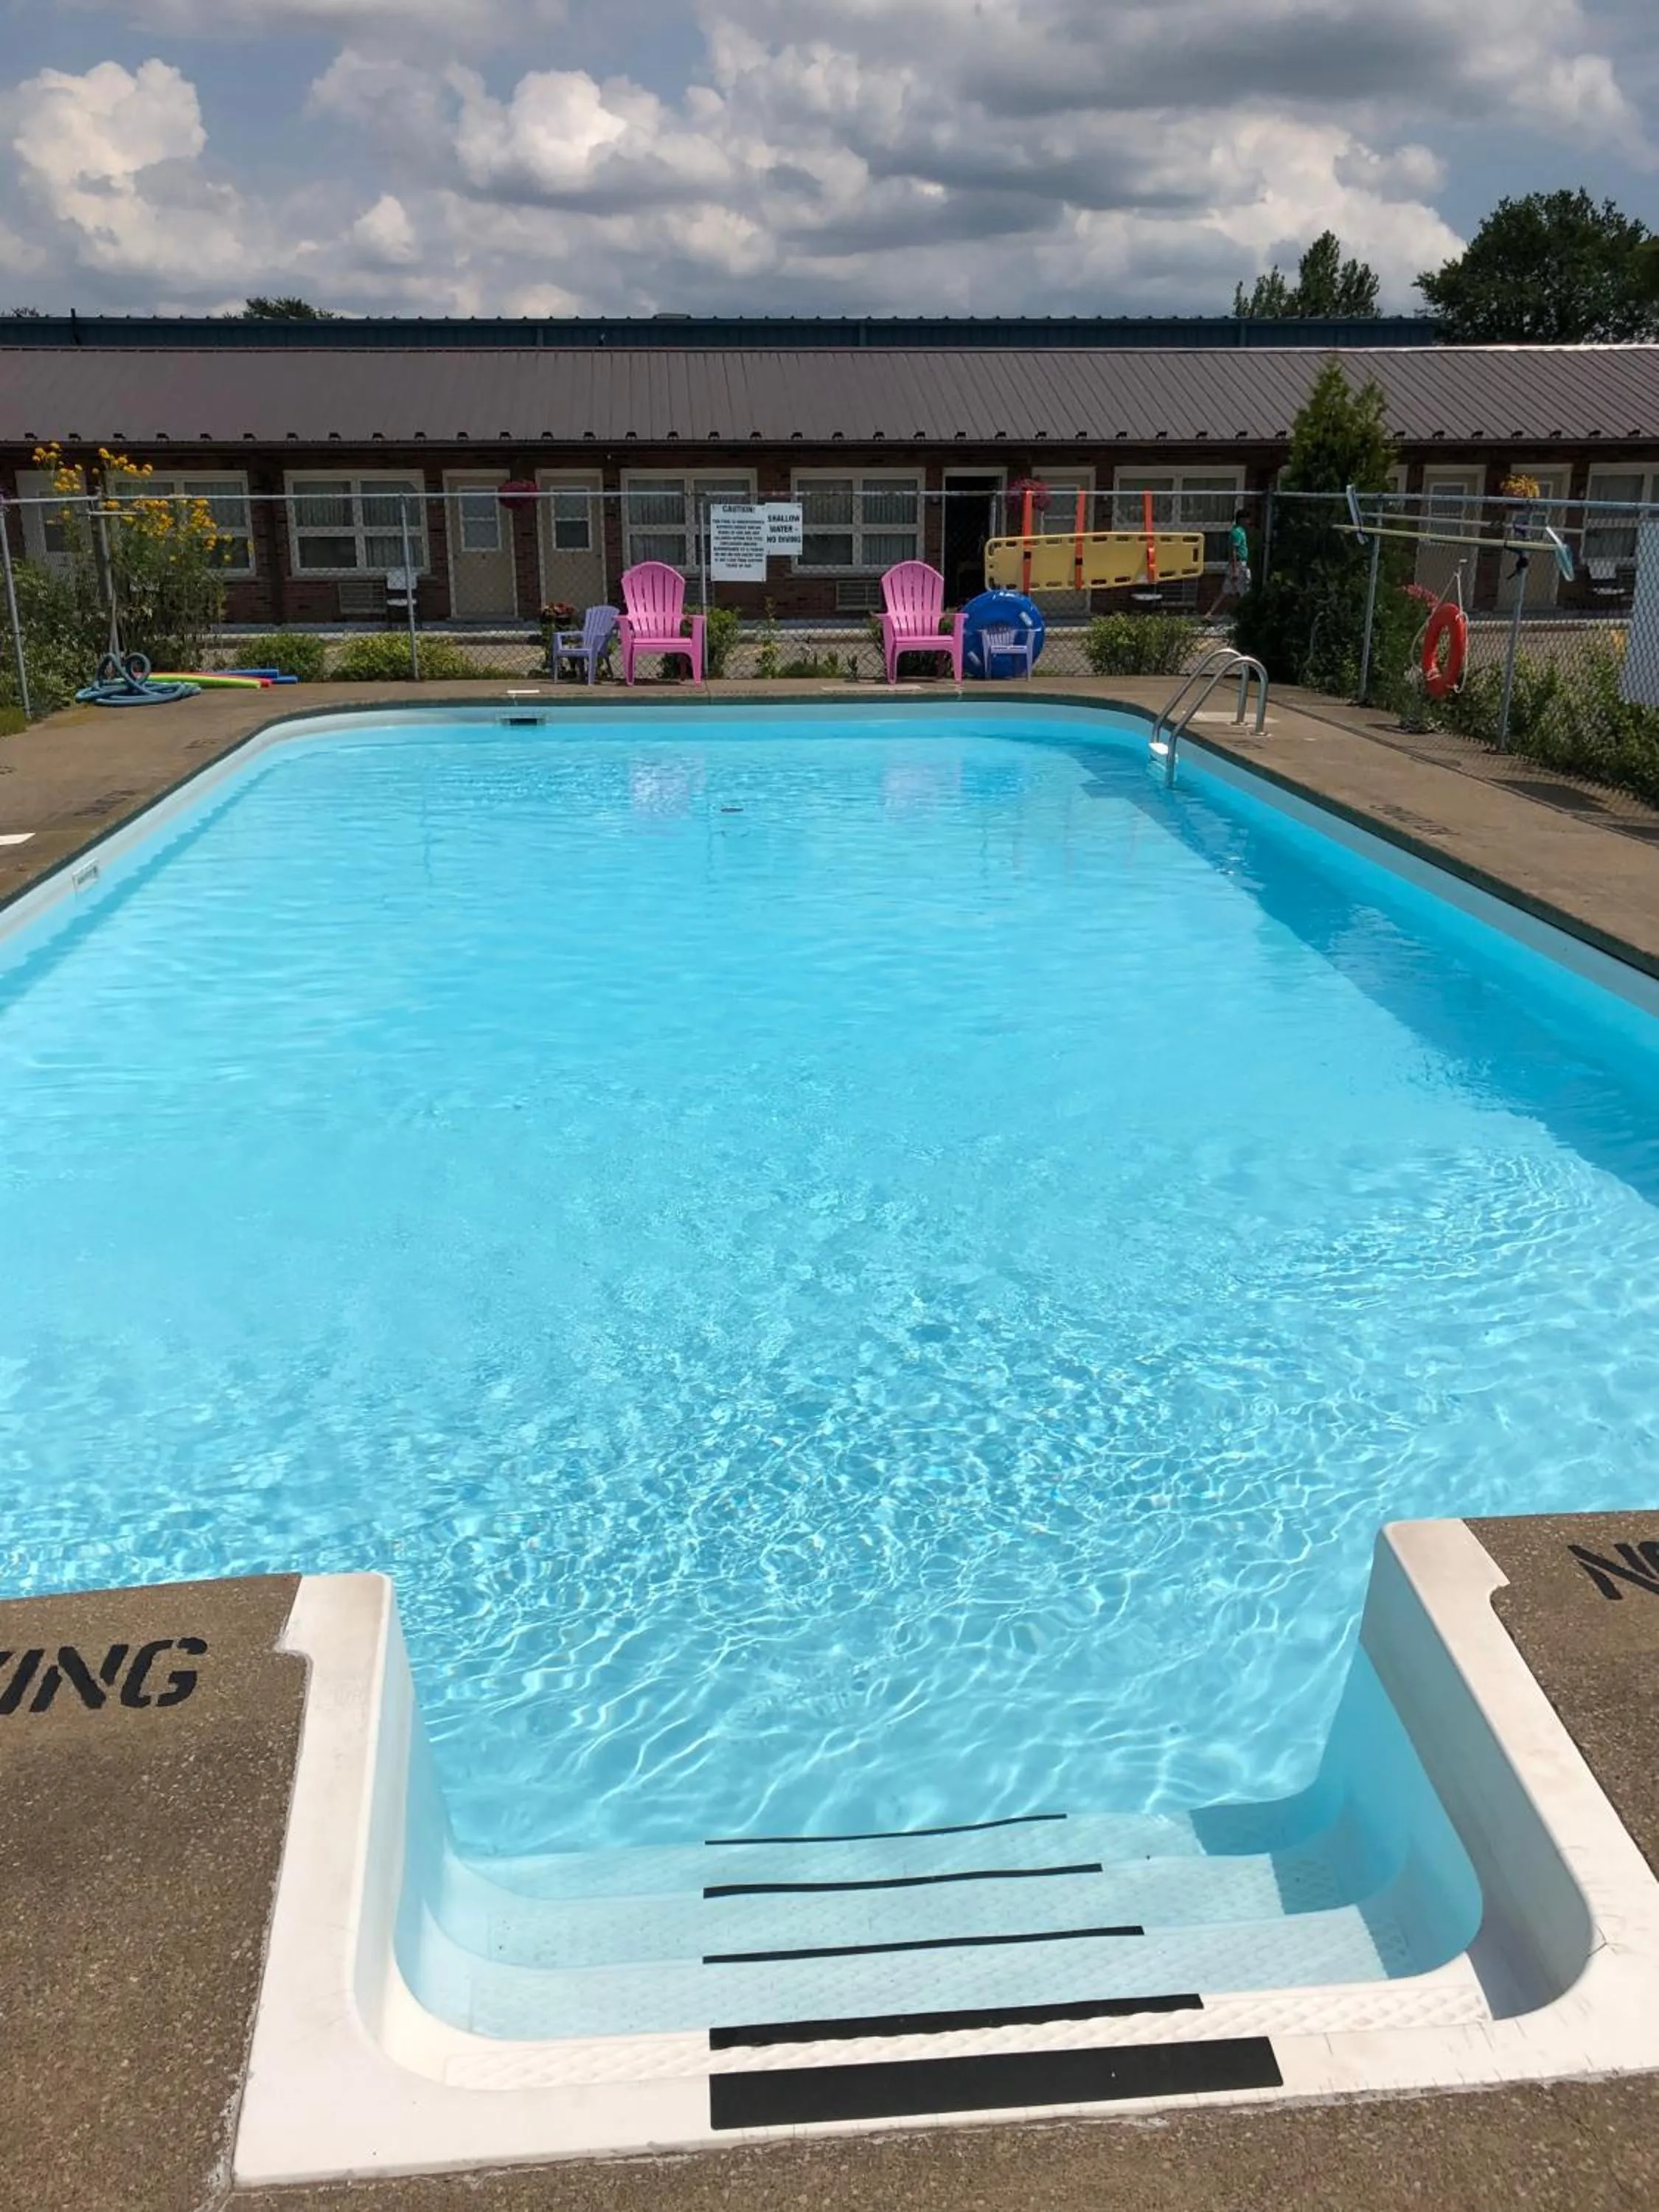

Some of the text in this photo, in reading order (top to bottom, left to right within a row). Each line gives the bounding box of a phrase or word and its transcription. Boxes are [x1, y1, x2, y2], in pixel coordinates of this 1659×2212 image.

[766, 535, 776, 543] NO
[778, 535, 801, 543] DIVING
[0, 1636, 208, 1715] ING
